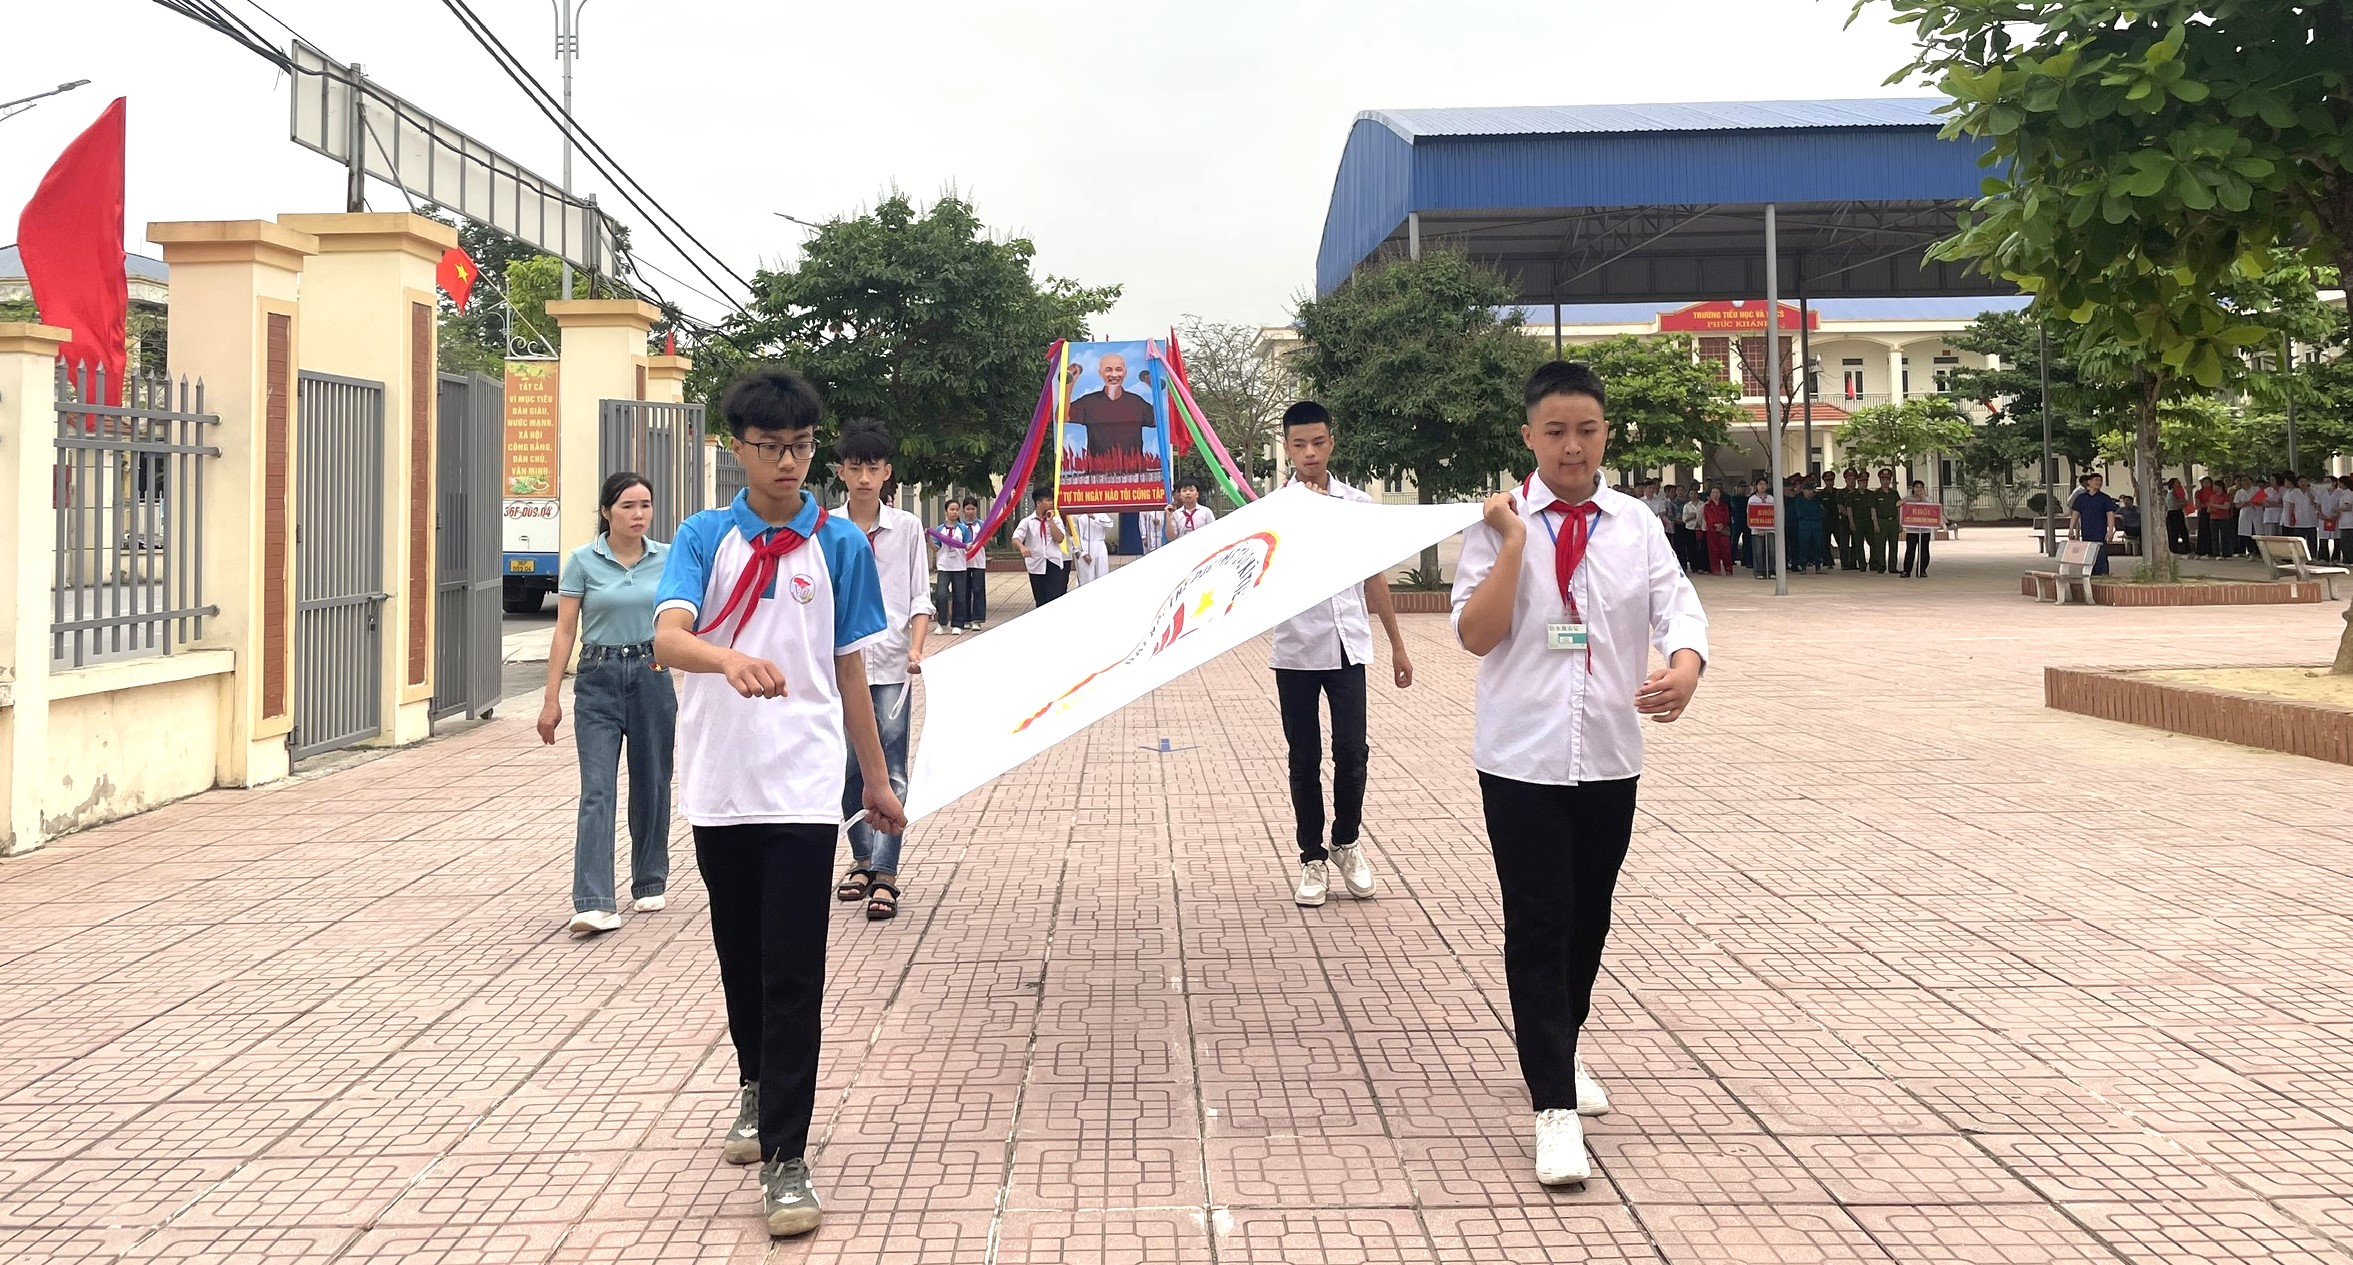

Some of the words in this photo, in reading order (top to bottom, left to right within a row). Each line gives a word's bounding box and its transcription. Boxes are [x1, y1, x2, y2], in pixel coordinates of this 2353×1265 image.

[1724, 308, 1738, 319] TIỂU
[1739, 311, 1754, 320] HỌC
[1756, 309, 1764, 319] VÀ
[519, 382, 532, 391] TẤT
[534, 380, 544, 391] CẢ
[509, 394, 516, 403] VÌ
[518, 395, 535, 405] MỤC
[536, 394, 553, 403] TIÊU
[512, 406, 528, 415] DÂN
[507, 418, 528, 427] NƯỚC
[518, 430, 528, 439] XÃ
[530, 430, 542, 441] HỘI
[508, 442, 528, 451] CÔNG
[512, 454, 528, 463] DÂN
[1073, 488, 1083, 502] TÔI
[1085, 488, 1103, 502] NGÀY
[1104, 488, 1118, 501] NÀO
[1120, 489, 1131, 501] TÔI
[1132, 487, 1150, 500] CŨNG
[1152, 487, 1165, 502] TẬP
